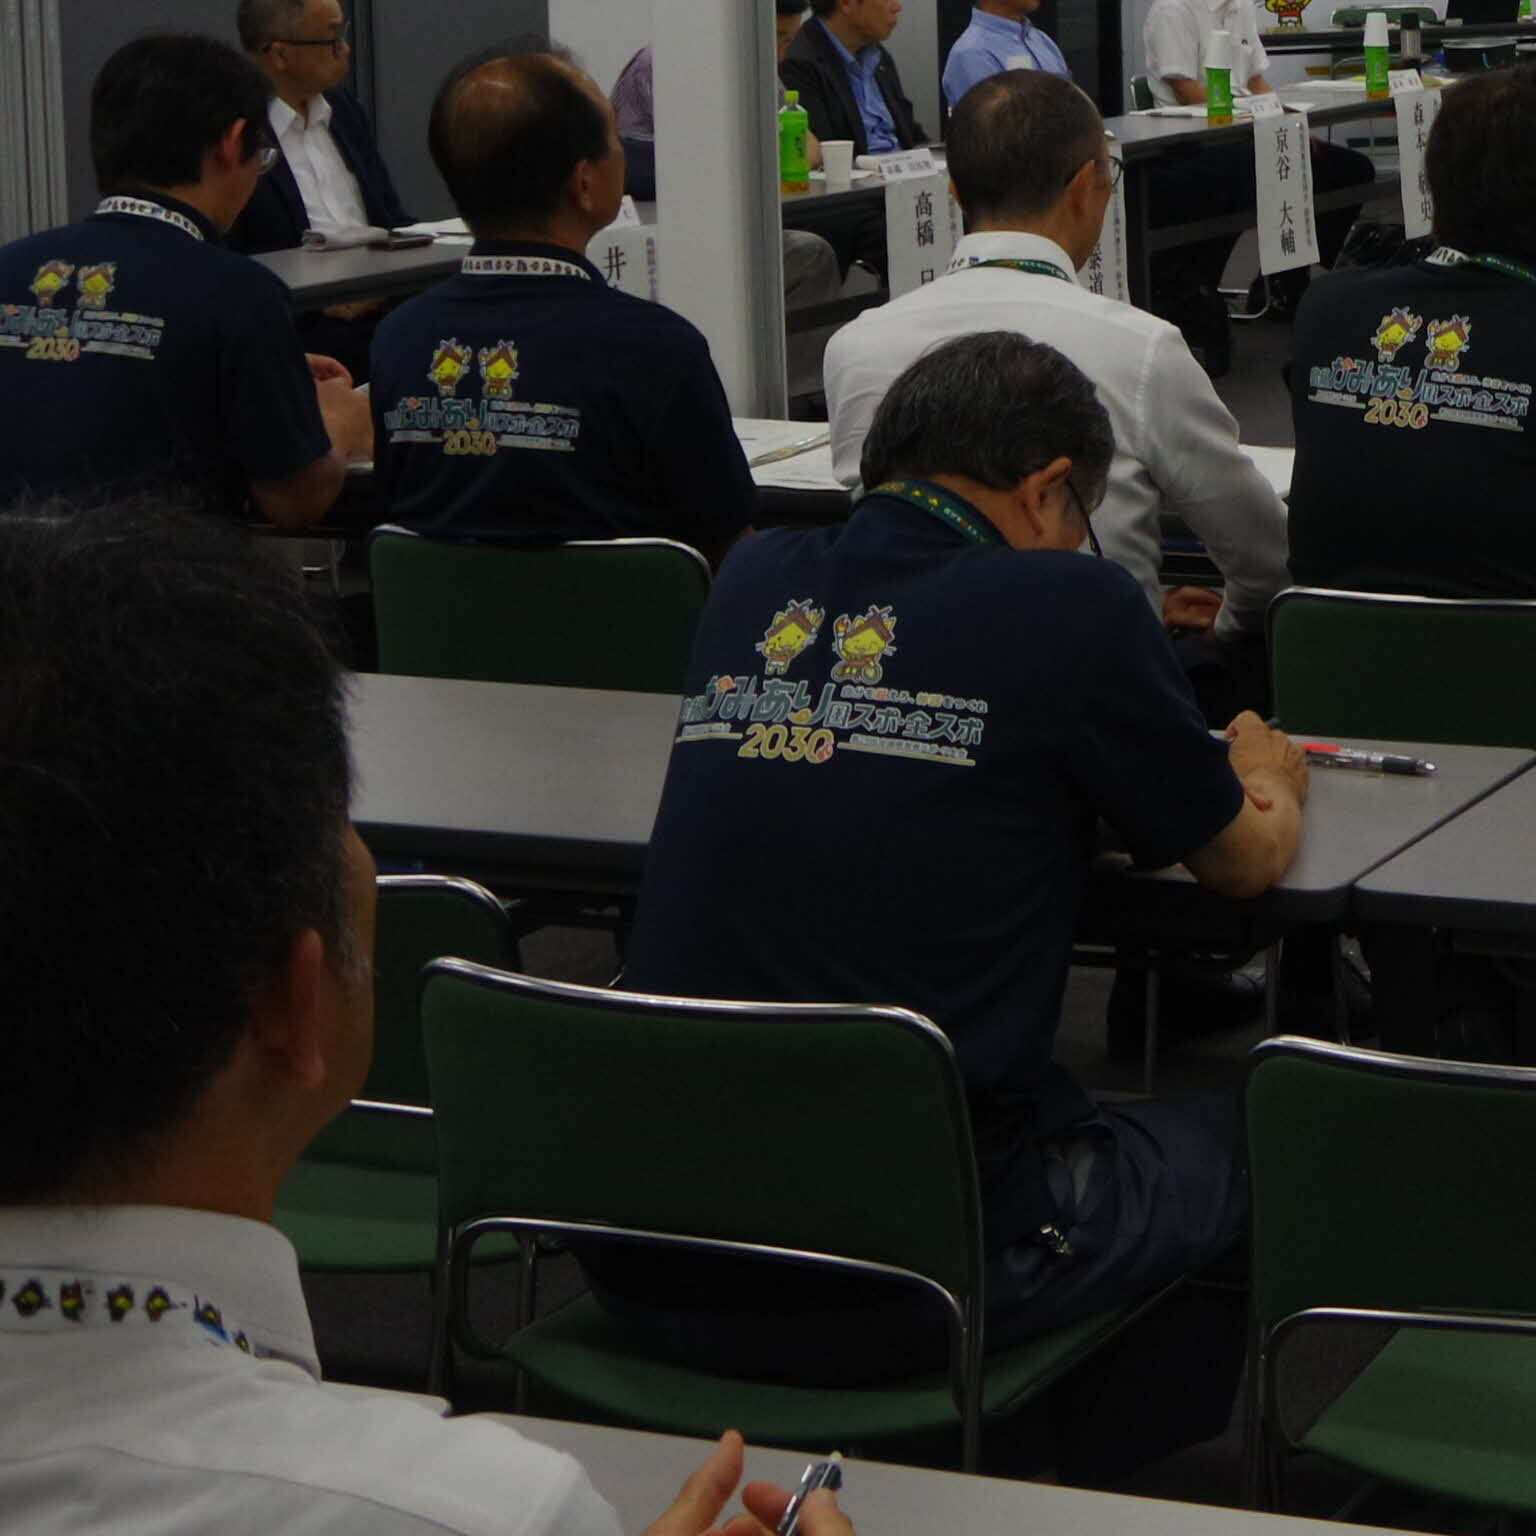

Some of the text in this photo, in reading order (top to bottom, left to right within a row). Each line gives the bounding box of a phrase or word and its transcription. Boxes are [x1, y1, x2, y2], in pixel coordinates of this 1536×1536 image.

[1275, 127, 1290, 182] 京谷
[914, 191, 935, 248] 高橋
[1364, 397, 1430, 430] 2030
[737, 723, 835, 764] 2030
